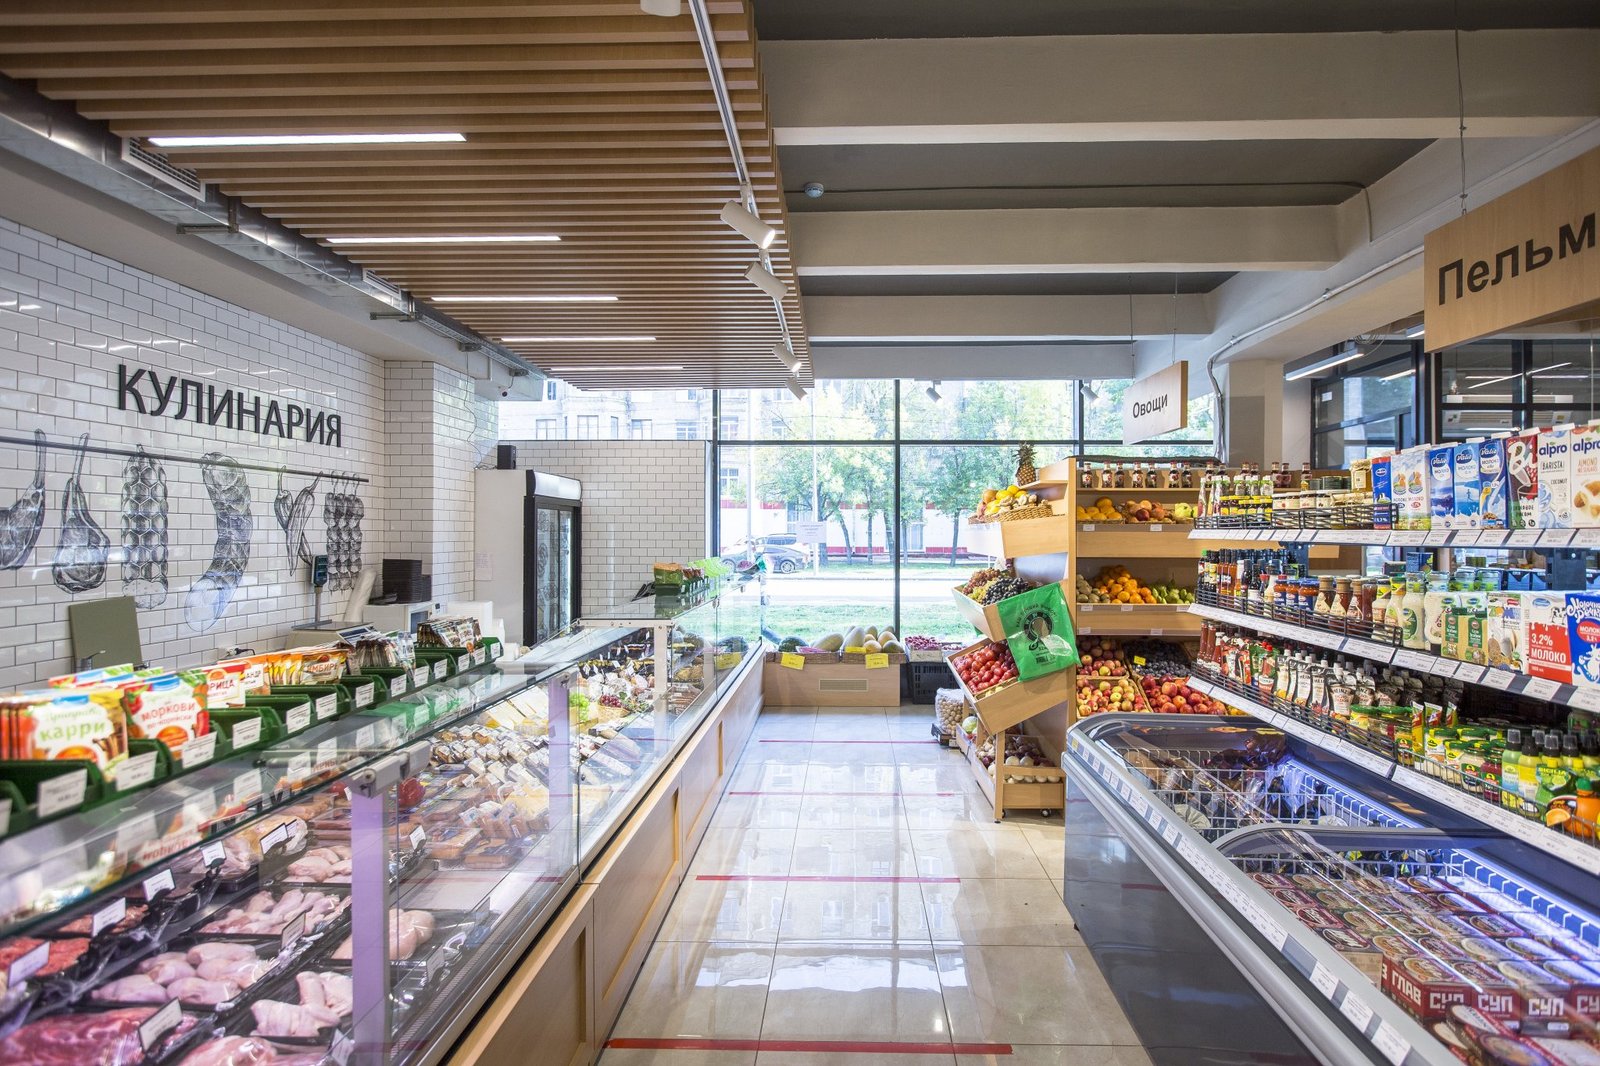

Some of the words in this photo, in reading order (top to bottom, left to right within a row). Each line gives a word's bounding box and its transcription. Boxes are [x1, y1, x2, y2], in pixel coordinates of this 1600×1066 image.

[1438, 212, 1596, 306] Пельм
[118, 363, 342, 448] КУЛИНАРИЯ
[1132, 393, 1168, 419] Овощи
[1538, 442, 1568, 458] alpro
[1531, 647, 1567, 664] МОЛОКО
[210, 679, 235, 690] РИЦА
[40, 722, 106, 742] карри
[1391, 968, 1422, 1006] ГЛАВ
[1477, 994, 1513, 1013] СУП
[1528, 997, 1565, 1016] СУП
